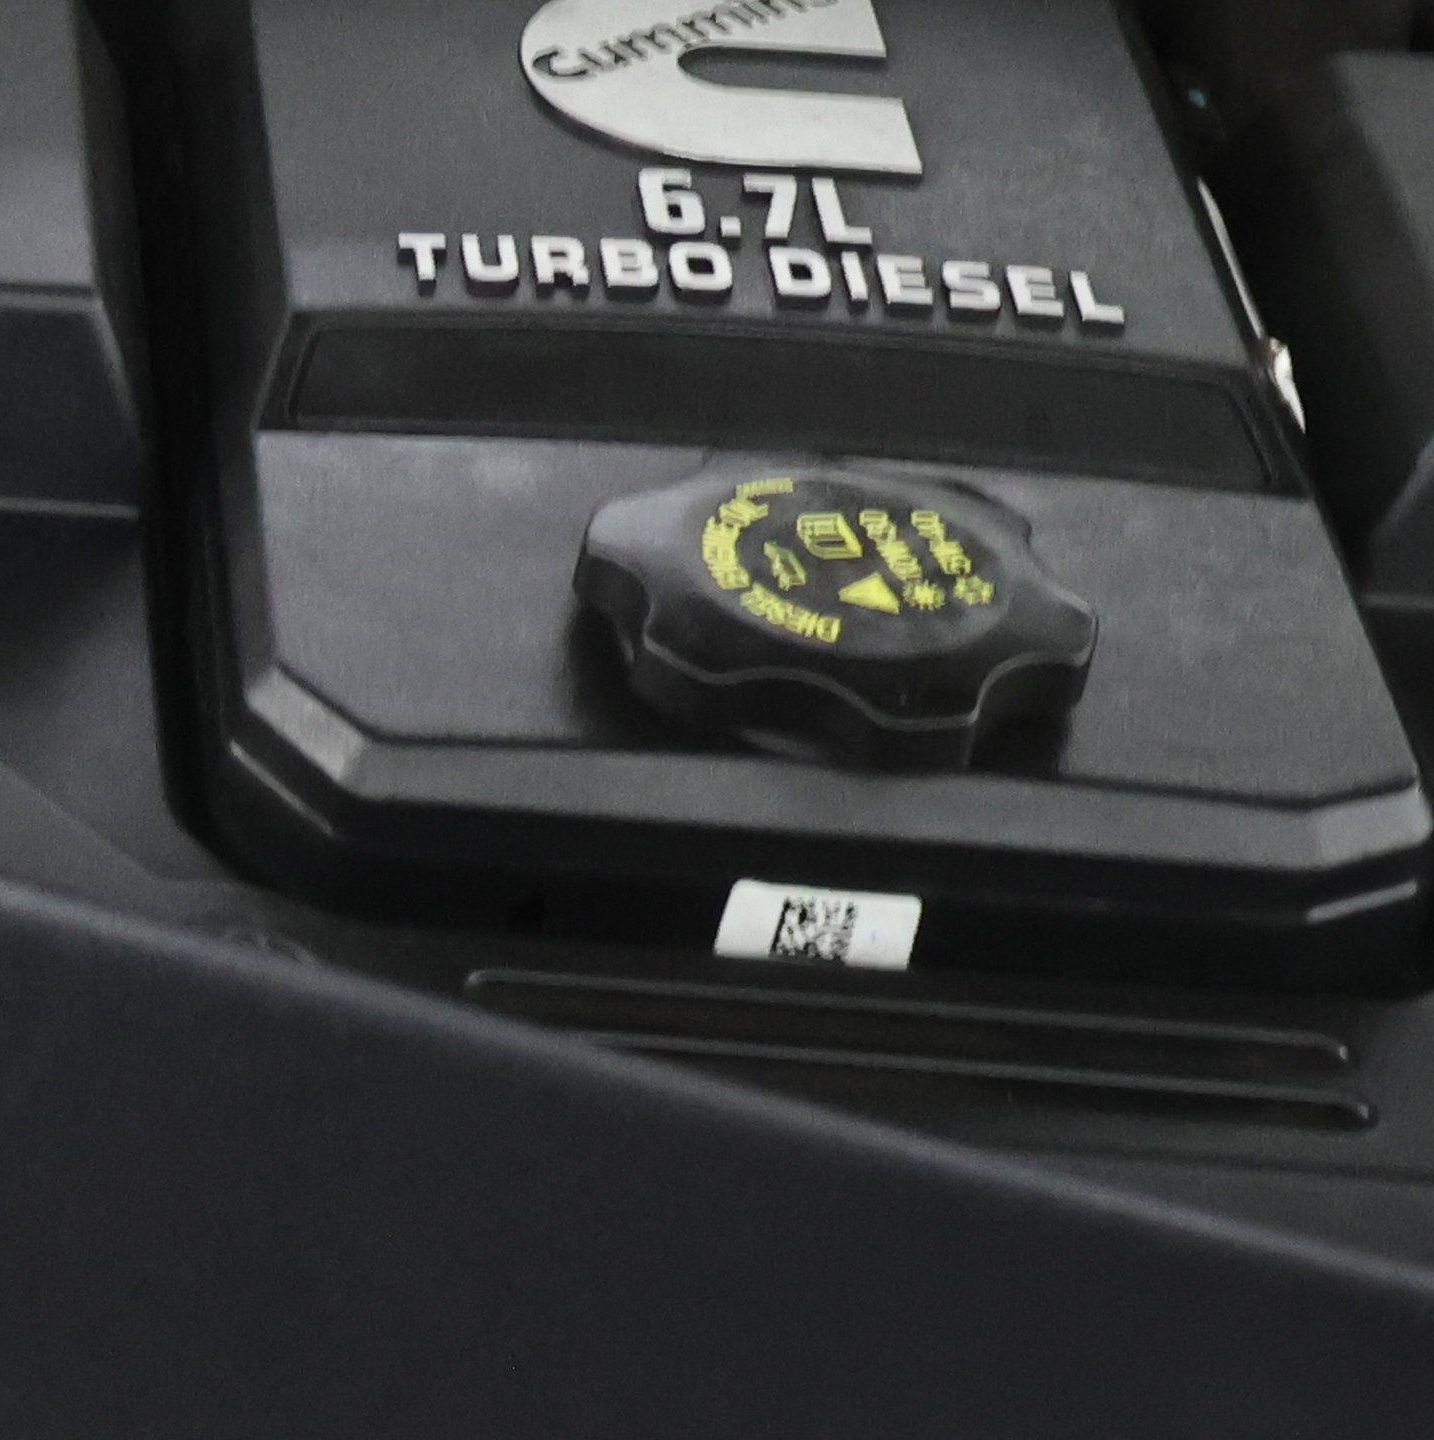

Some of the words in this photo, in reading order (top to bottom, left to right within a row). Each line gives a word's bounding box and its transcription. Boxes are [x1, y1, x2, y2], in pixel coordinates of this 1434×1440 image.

[637, 166, 873, 246] 6.7L
[398, 232, 734, 294] TURBO
[767, 245, 1125, 325] DIESEL
